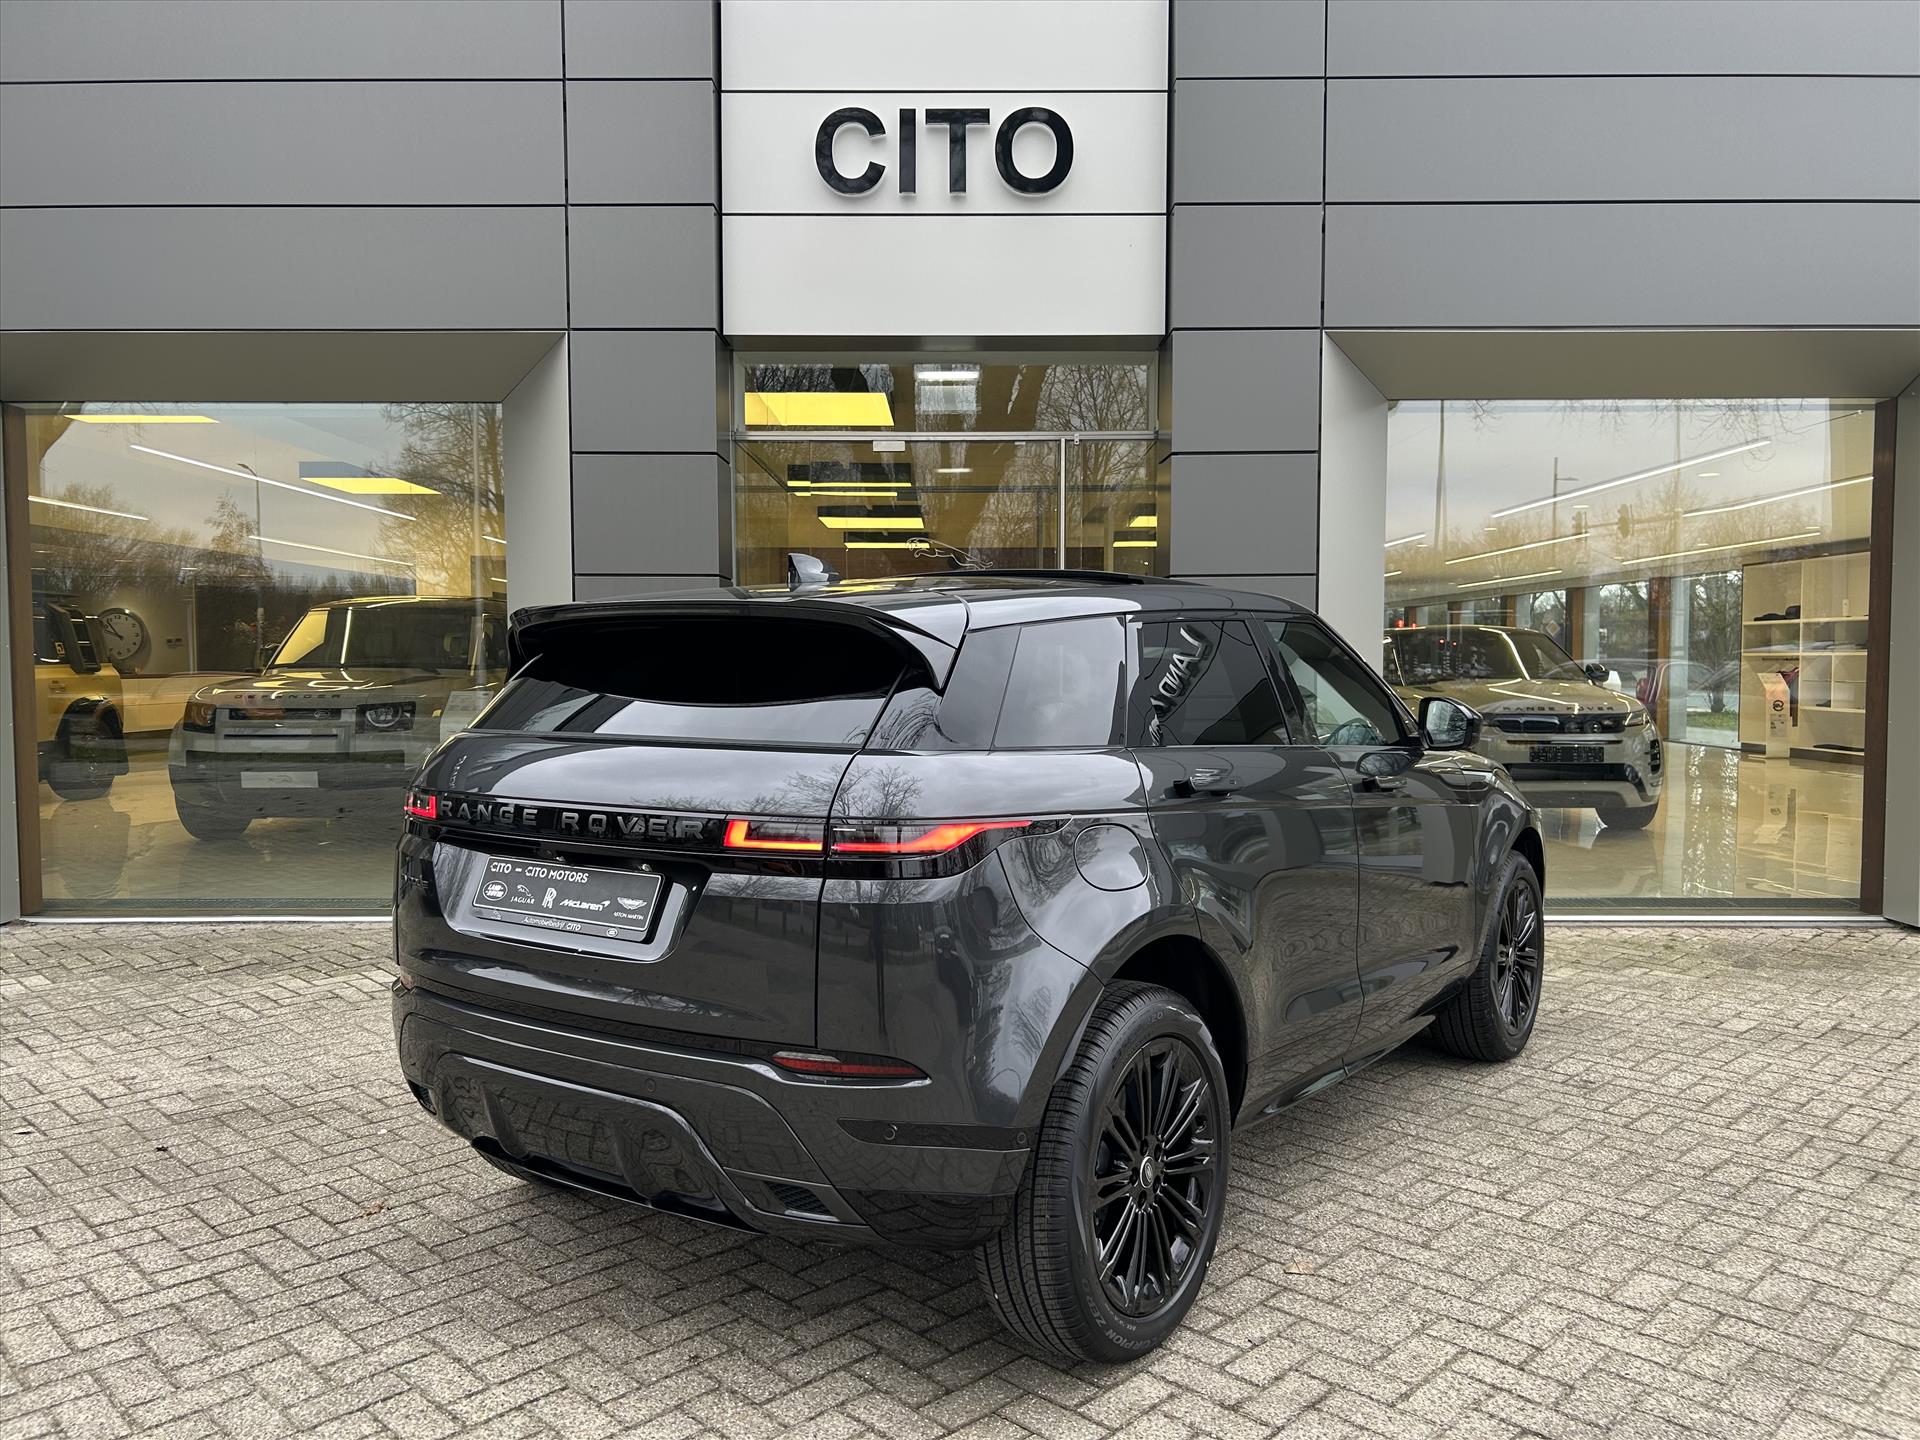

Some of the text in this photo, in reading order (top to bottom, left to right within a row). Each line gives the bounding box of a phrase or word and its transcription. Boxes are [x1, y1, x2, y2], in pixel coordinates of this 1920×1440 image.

[814, 106, 1075, 194] CITO
[440, 799, 704, 840] RANGE ROVER
[490, 862, 512, 874] CITO
[525, 866, 547, 878] CITO
[548, 869, 589, 883] MOTORS
[510, 895, 535, 905] JAGUAR
[566, 922, 582, 931] CITO
